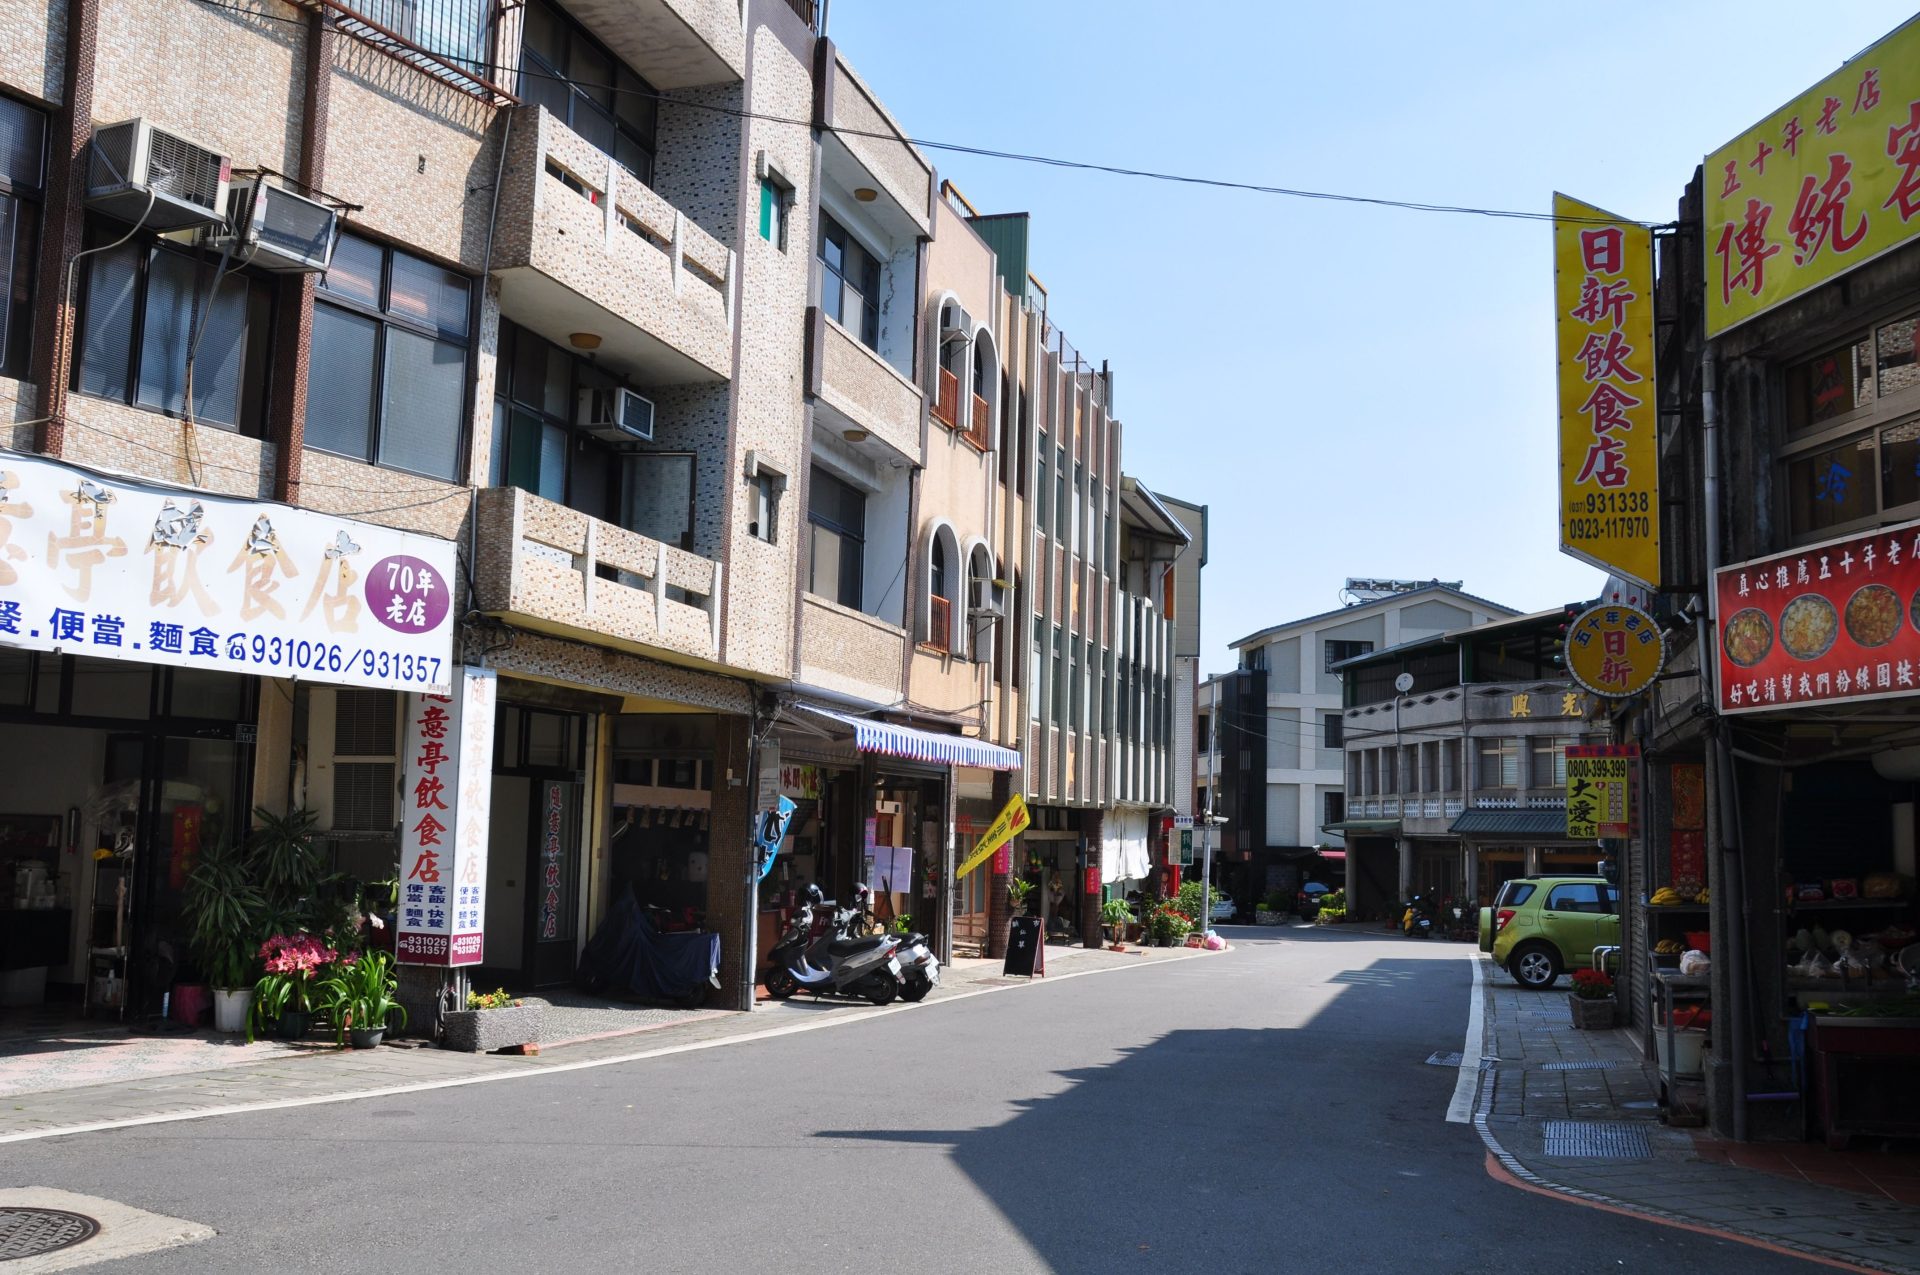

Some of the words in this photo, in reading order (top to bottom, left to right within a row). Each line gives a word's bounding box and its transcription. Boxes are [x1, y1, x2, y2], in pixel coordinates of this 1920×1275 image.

[1720, 68, 1882, 200] 五十年老店
[1570, 227, 1642, 490] 日新飲食店
[1570, 515, 1649, 540] 0923-117970
[385, 560, 435, 595] 70年
[385, 597, 427, 627] 老店
[1575, 611, 1655, 647] 五十年老店
[1598, 629, 1634, 688] 日新
[1729, 658, 1920, 706] 好吃請幫我們粉絲團按
[459, 675, 488, 884] 隨意亭飲食店
[1567, 759, 1626, 778] 0800-399-399
[408, 690, 454, 883] 意亭飲食店
[1568, 778, 1598, 824] 大愛
[408, 936, 448, 947] 931026
[408, 945, 447, 955] 931357
[456, 944, 480, 955] 931357
[457, 936, 480, 945] 931026
